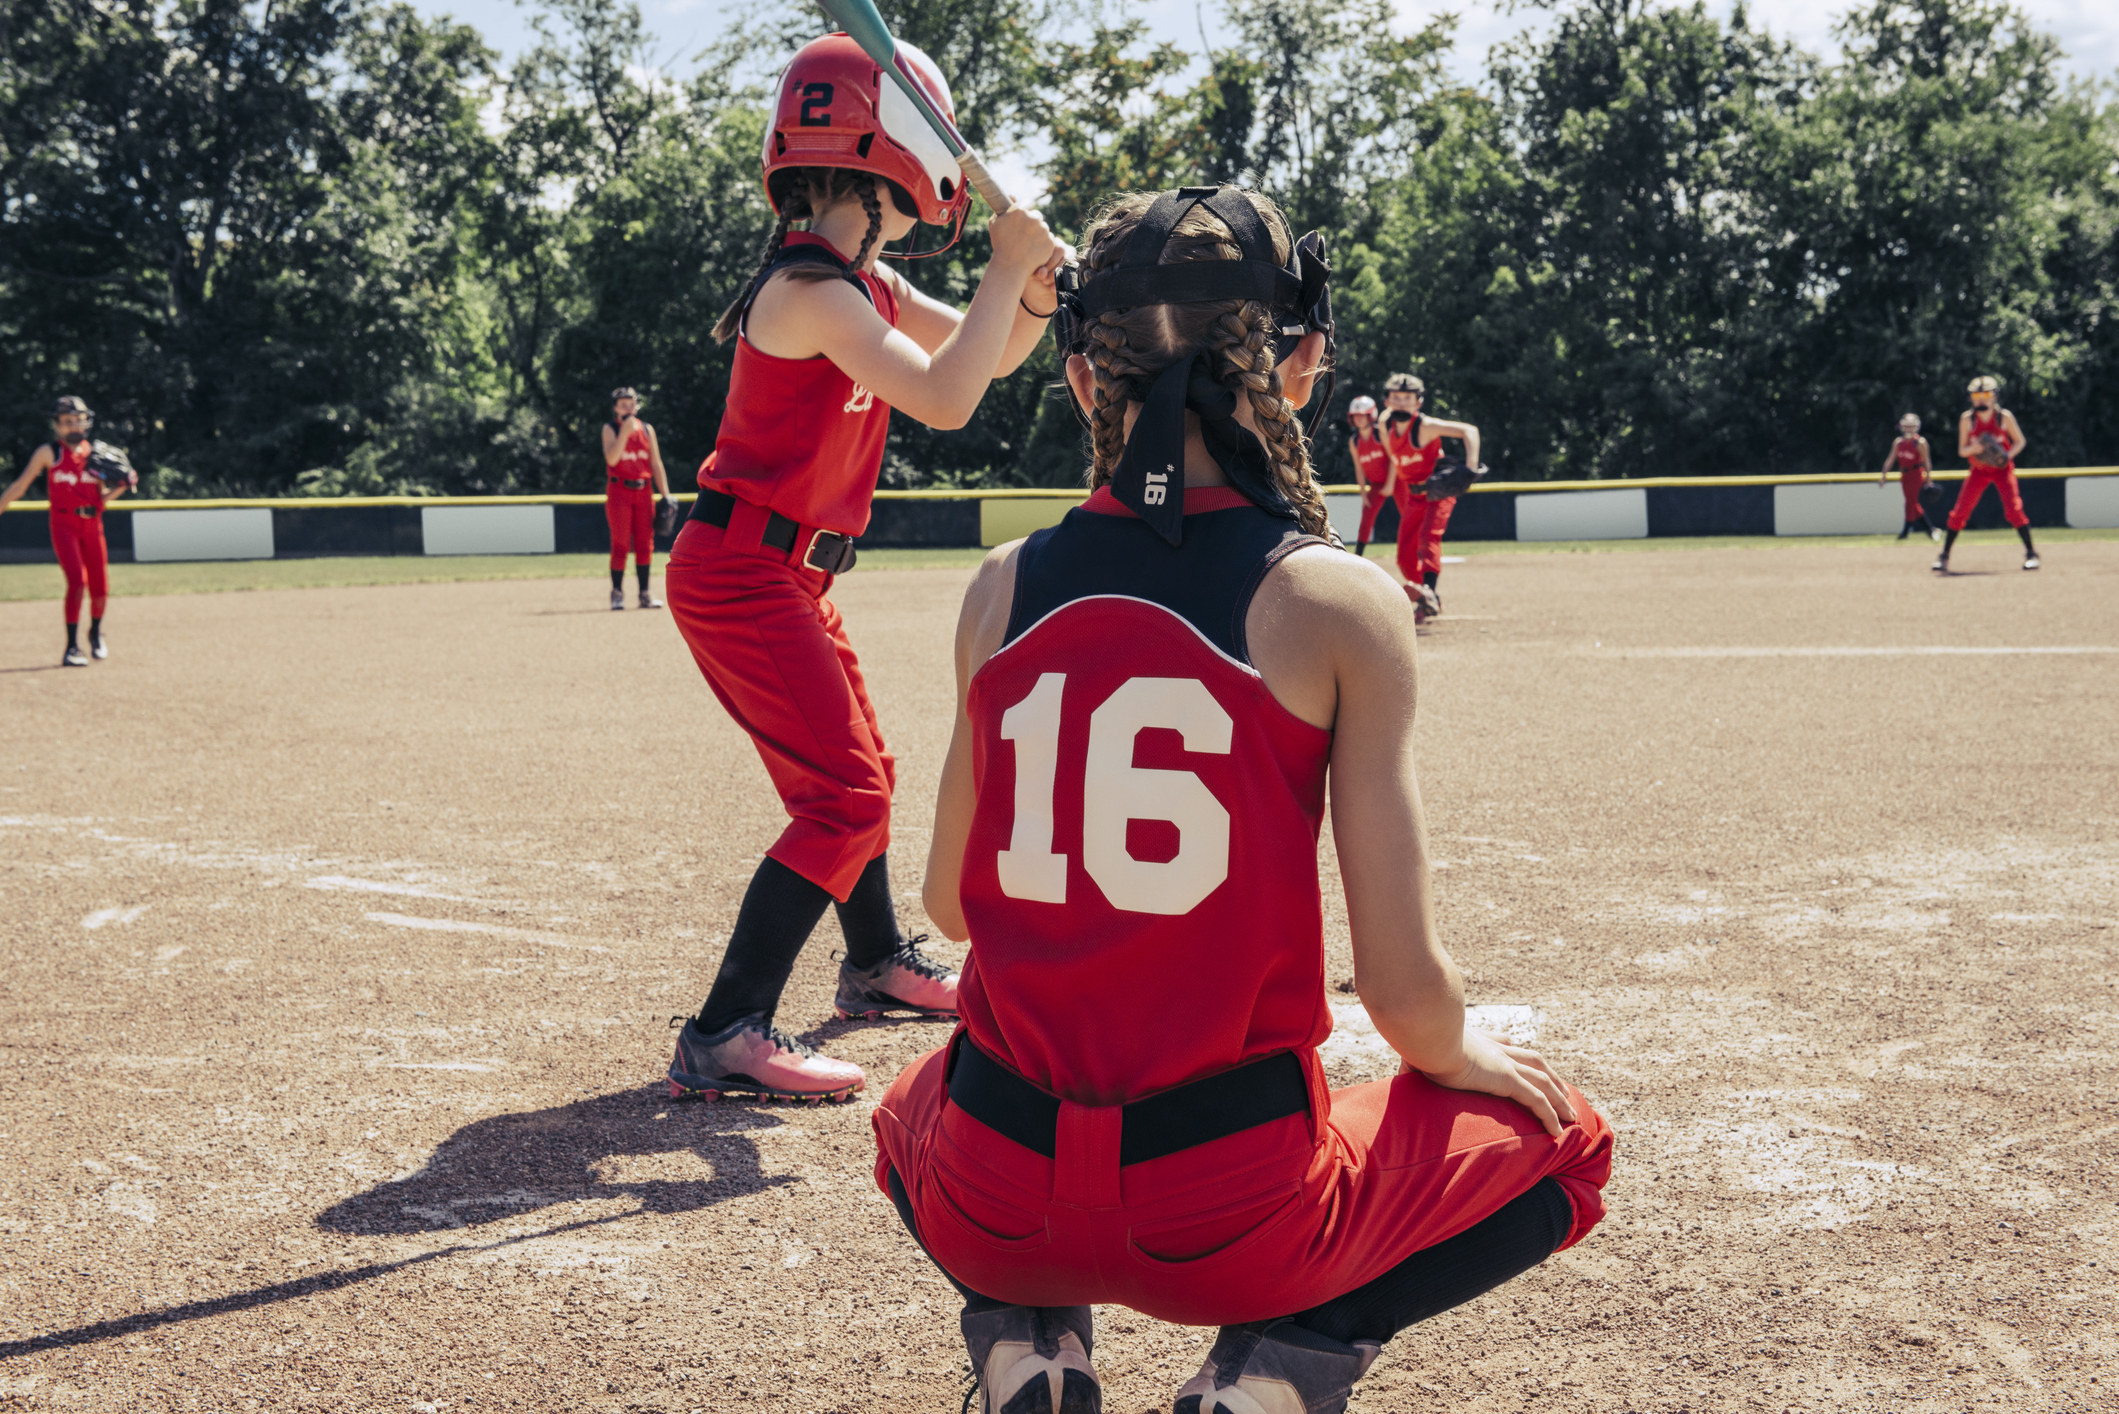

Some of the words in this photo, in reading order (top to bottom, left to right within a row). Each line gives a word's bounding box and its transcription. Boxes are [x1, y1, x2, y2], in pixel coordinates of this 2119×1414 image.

[791, 78, 835, 127] #2
[1144, 463, 1175, 506] #16
[997, 672, 1234, 915] 16
